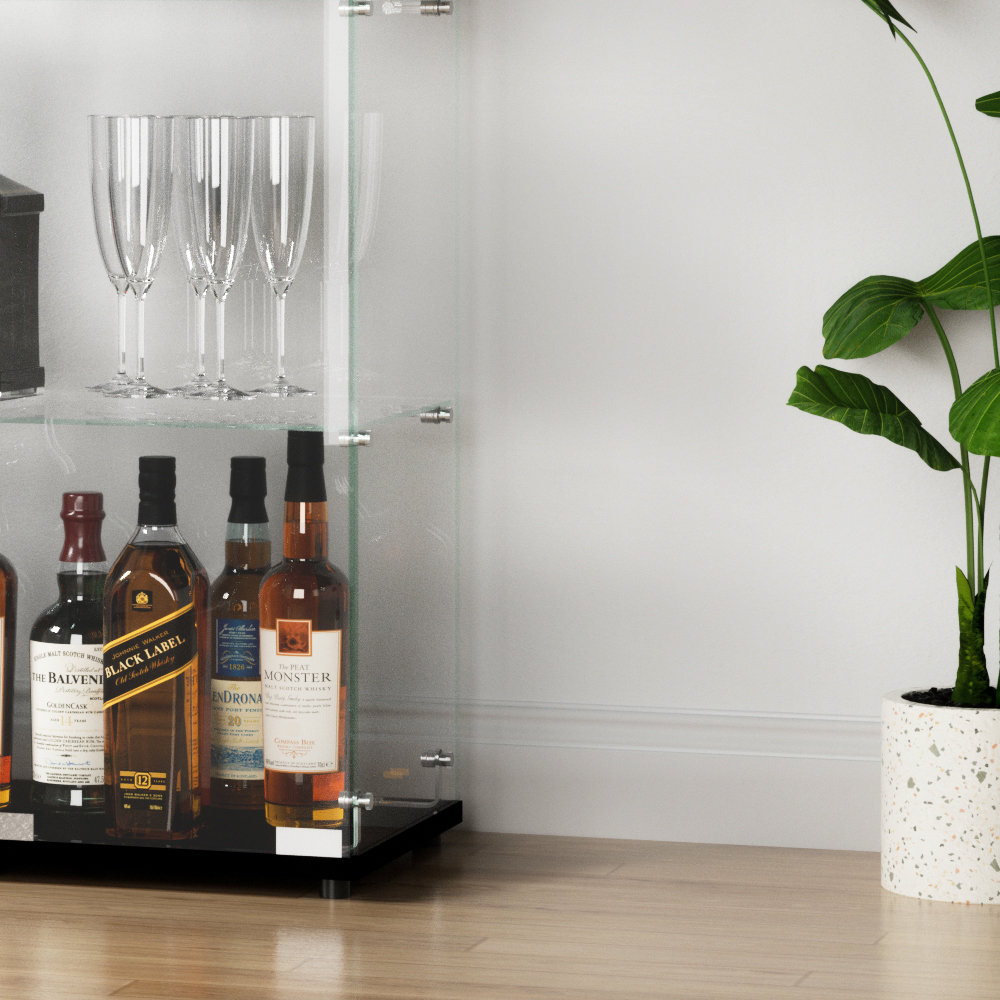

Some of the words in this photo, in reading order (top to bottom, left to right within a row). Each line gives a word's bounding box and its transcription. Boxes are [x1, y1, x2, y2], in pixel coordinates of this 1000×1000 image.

[112, 643, 140, 660] JOHNNIE
[142, 630, 169, 646] WALKER
[62, 650, 85, 659] SCOTCH
[104, 652, 144, 679] BLACK
[144, 634, 186, 660] LABEL
[32, 672, 46, 682] THE
[48, 671, 104, 684] BALVENI
[264, 669, 332, 683] MONSTER
[212, 690, 262, 705] ENDRONA
[227, 715, 241, 727] 20
[138, 775, 148, 786] 12
